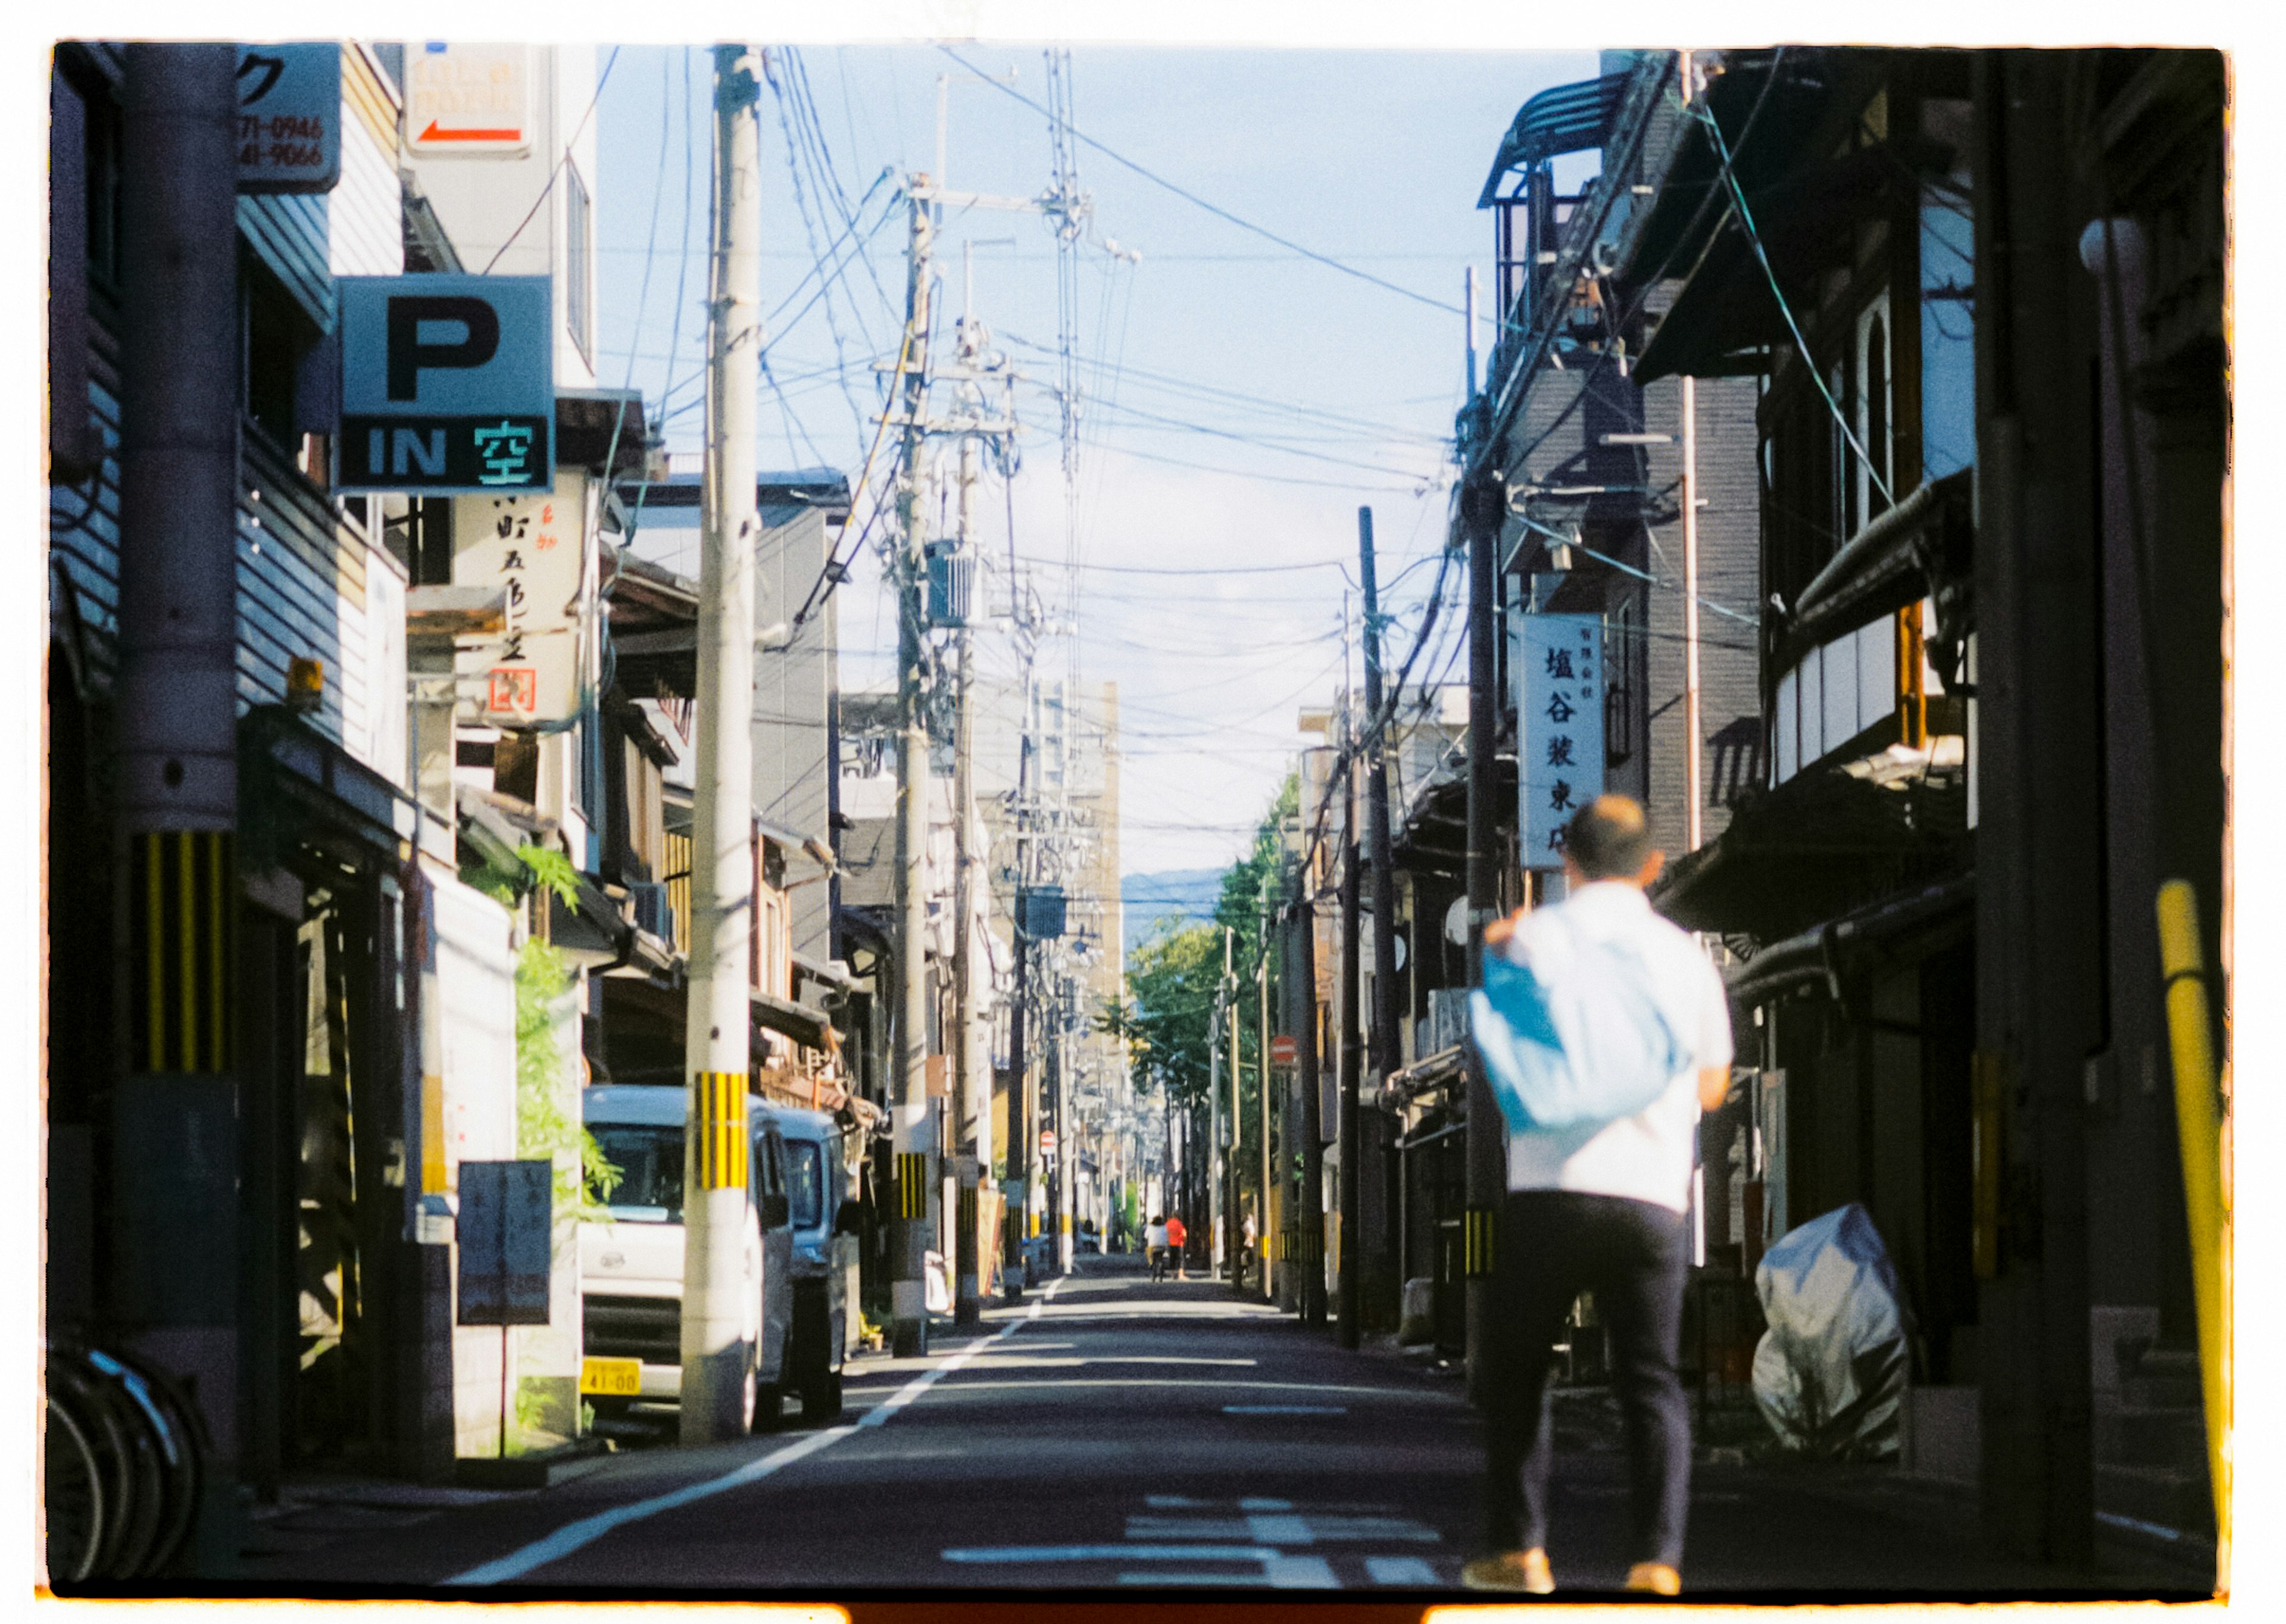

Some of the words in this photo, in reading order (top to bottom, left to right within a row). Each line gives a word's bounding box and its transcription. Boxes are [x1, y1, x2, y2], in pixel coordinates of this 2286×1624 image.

[387, 296, 499, 401] P
[368, 428, 446, 476] IN
[474, 420, 532, 485] 空
